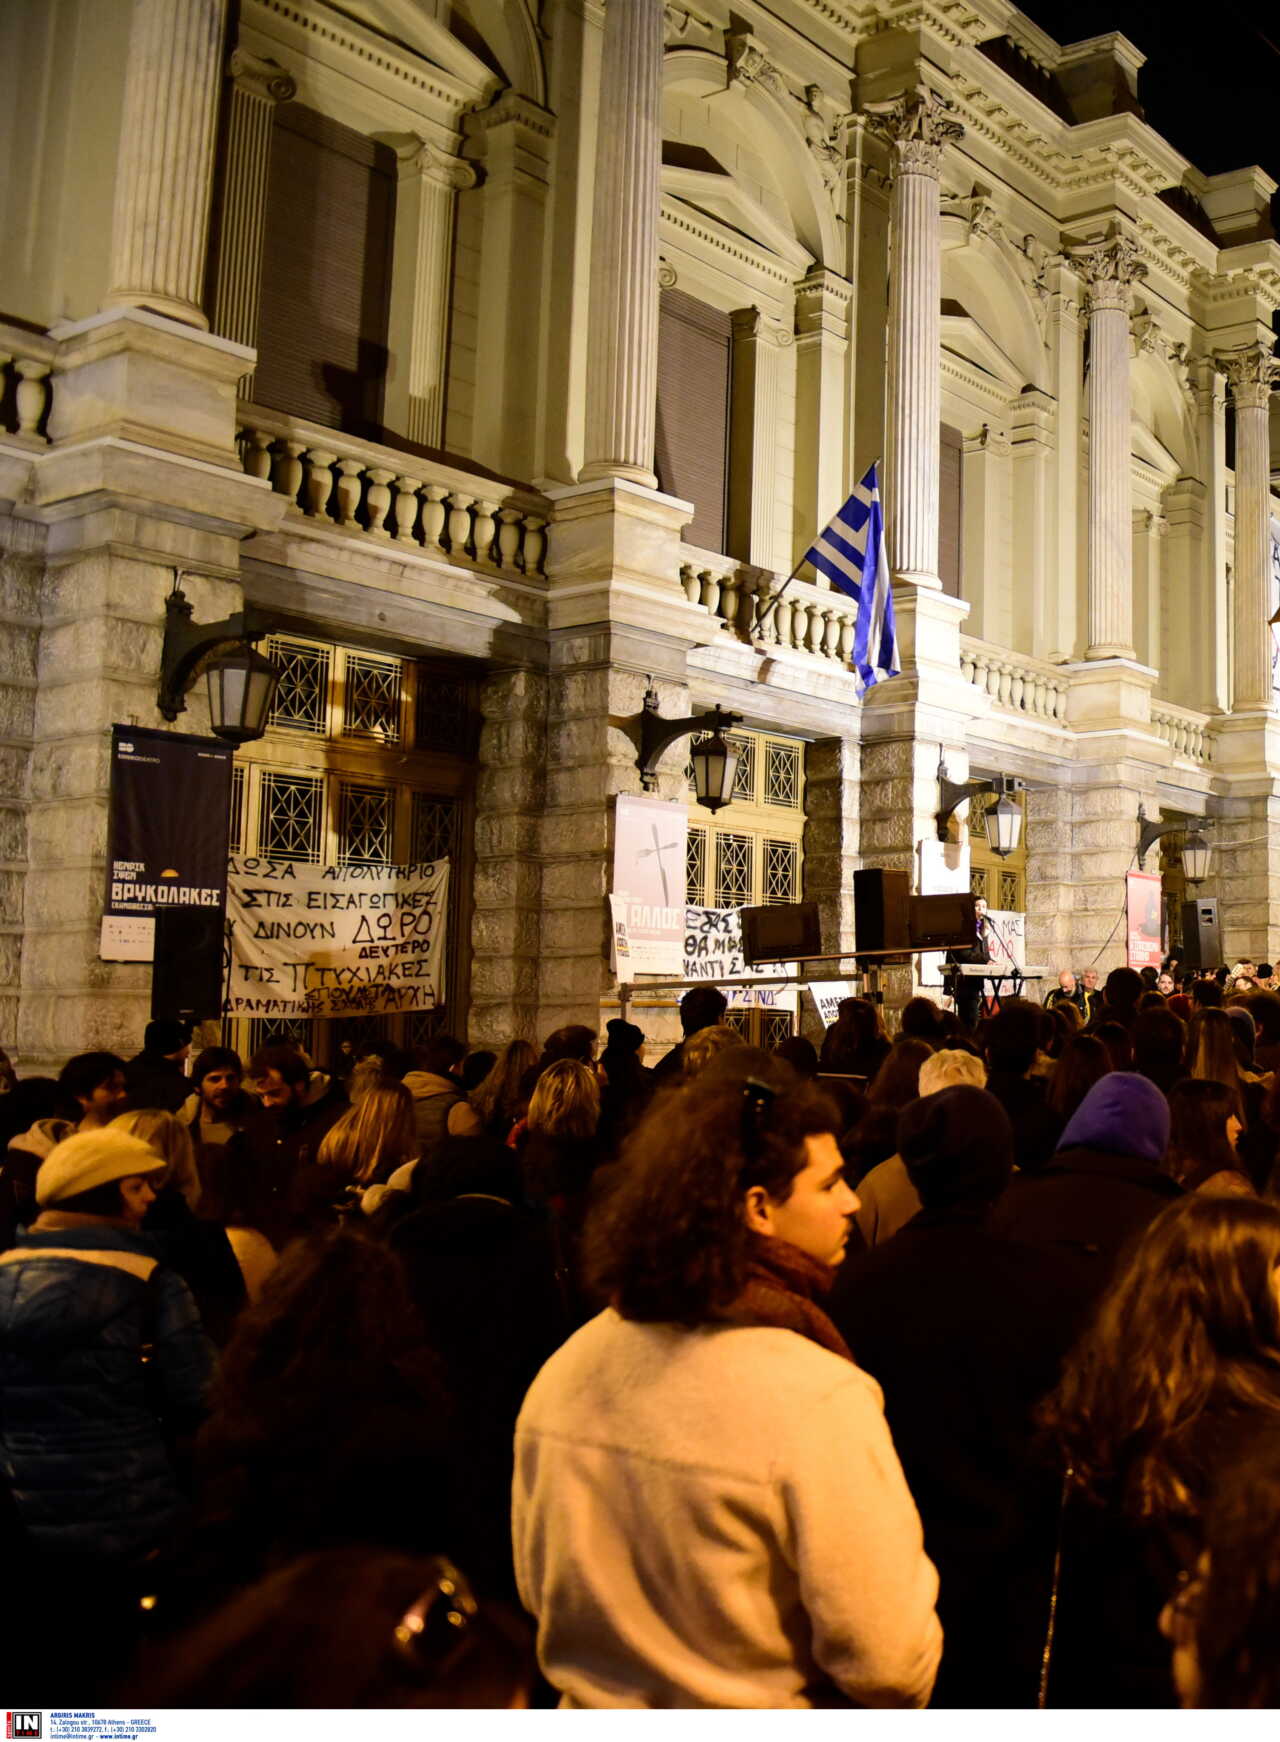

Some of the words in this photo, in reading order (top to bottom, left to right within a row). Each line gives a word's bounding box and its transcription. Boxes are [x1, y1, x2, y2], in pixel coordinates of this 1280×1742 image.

[112, 882, 220, 906] ΒΡΥΚΟΛΑΚΕΣ
[242, 889, 293, 908] ΣΤΙΣ
[254, 921, 335, 940] ΔΙΝΟΥΝ
[353, 911, 432, 944] ΔΩΡΟ
[359, 940, 430, 959] ΔΕΥΤΕΡΟ
[684, 935, 708, 957] ΘΑ
[239, 965, 280, 983] ΤΙΣ
[283, 959, 430, 992] ΠΤΥΧΙΑΚΕΣ
